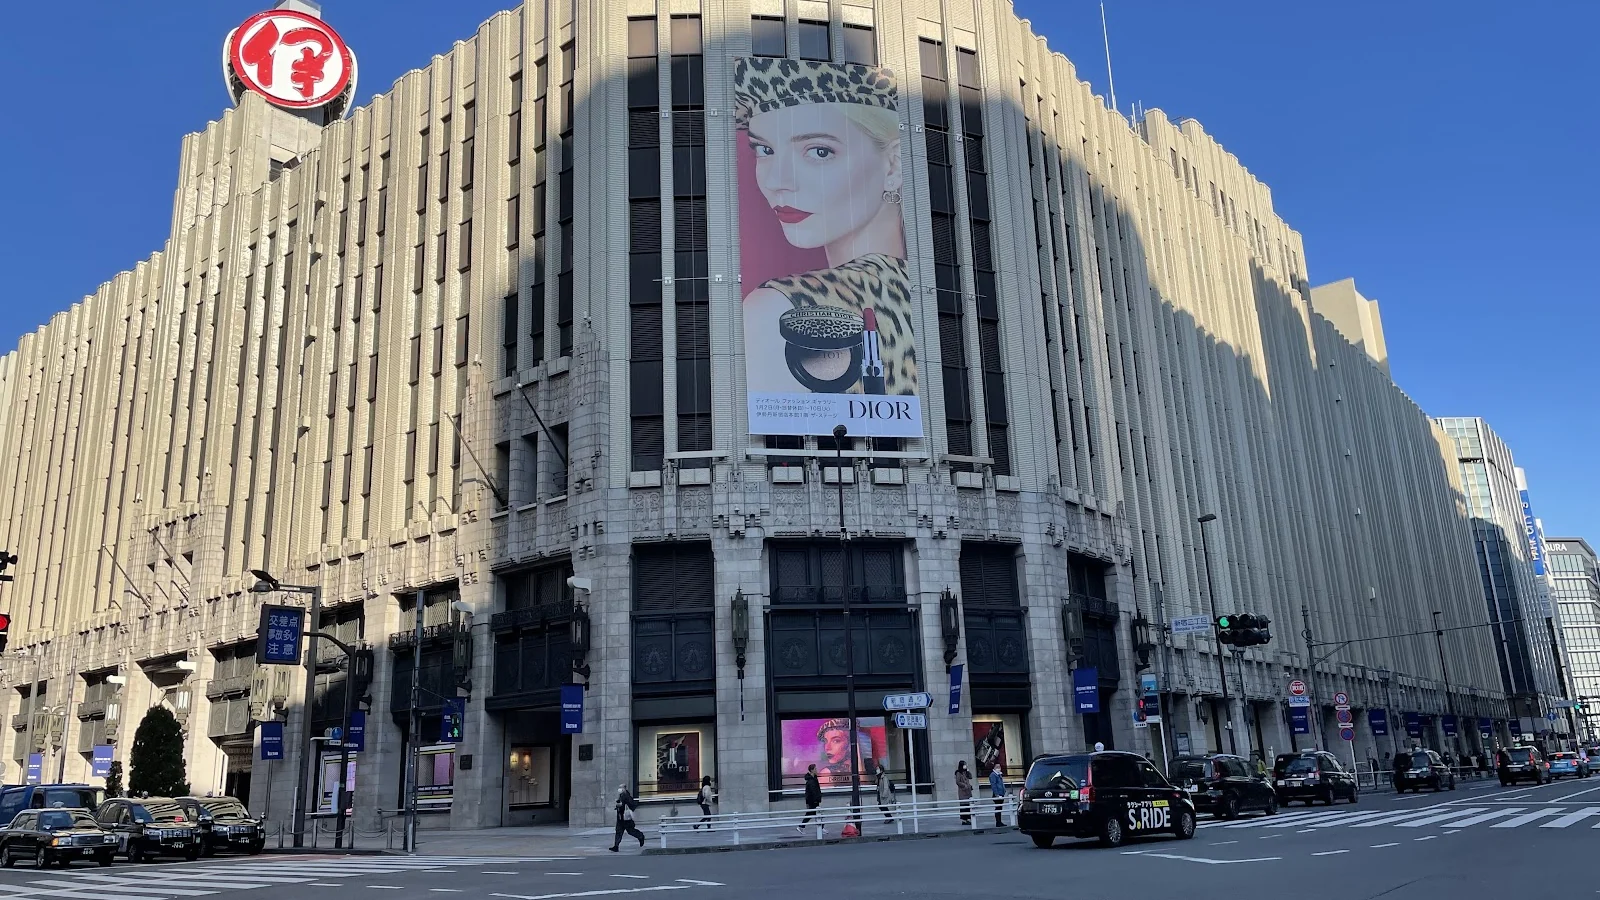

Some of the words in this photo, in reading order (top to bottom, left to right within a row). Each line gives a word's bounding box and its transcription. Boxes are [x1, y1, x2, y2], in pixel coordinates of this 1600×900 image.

[848, 400, 914, 420] DIOR
[269, 615, 298, 628] 交差点
[268, 629, 296, 642] 事故多し
[268, 642, 294, 656] 注意
[1128, 806, 1171, 830] S.RIDE
